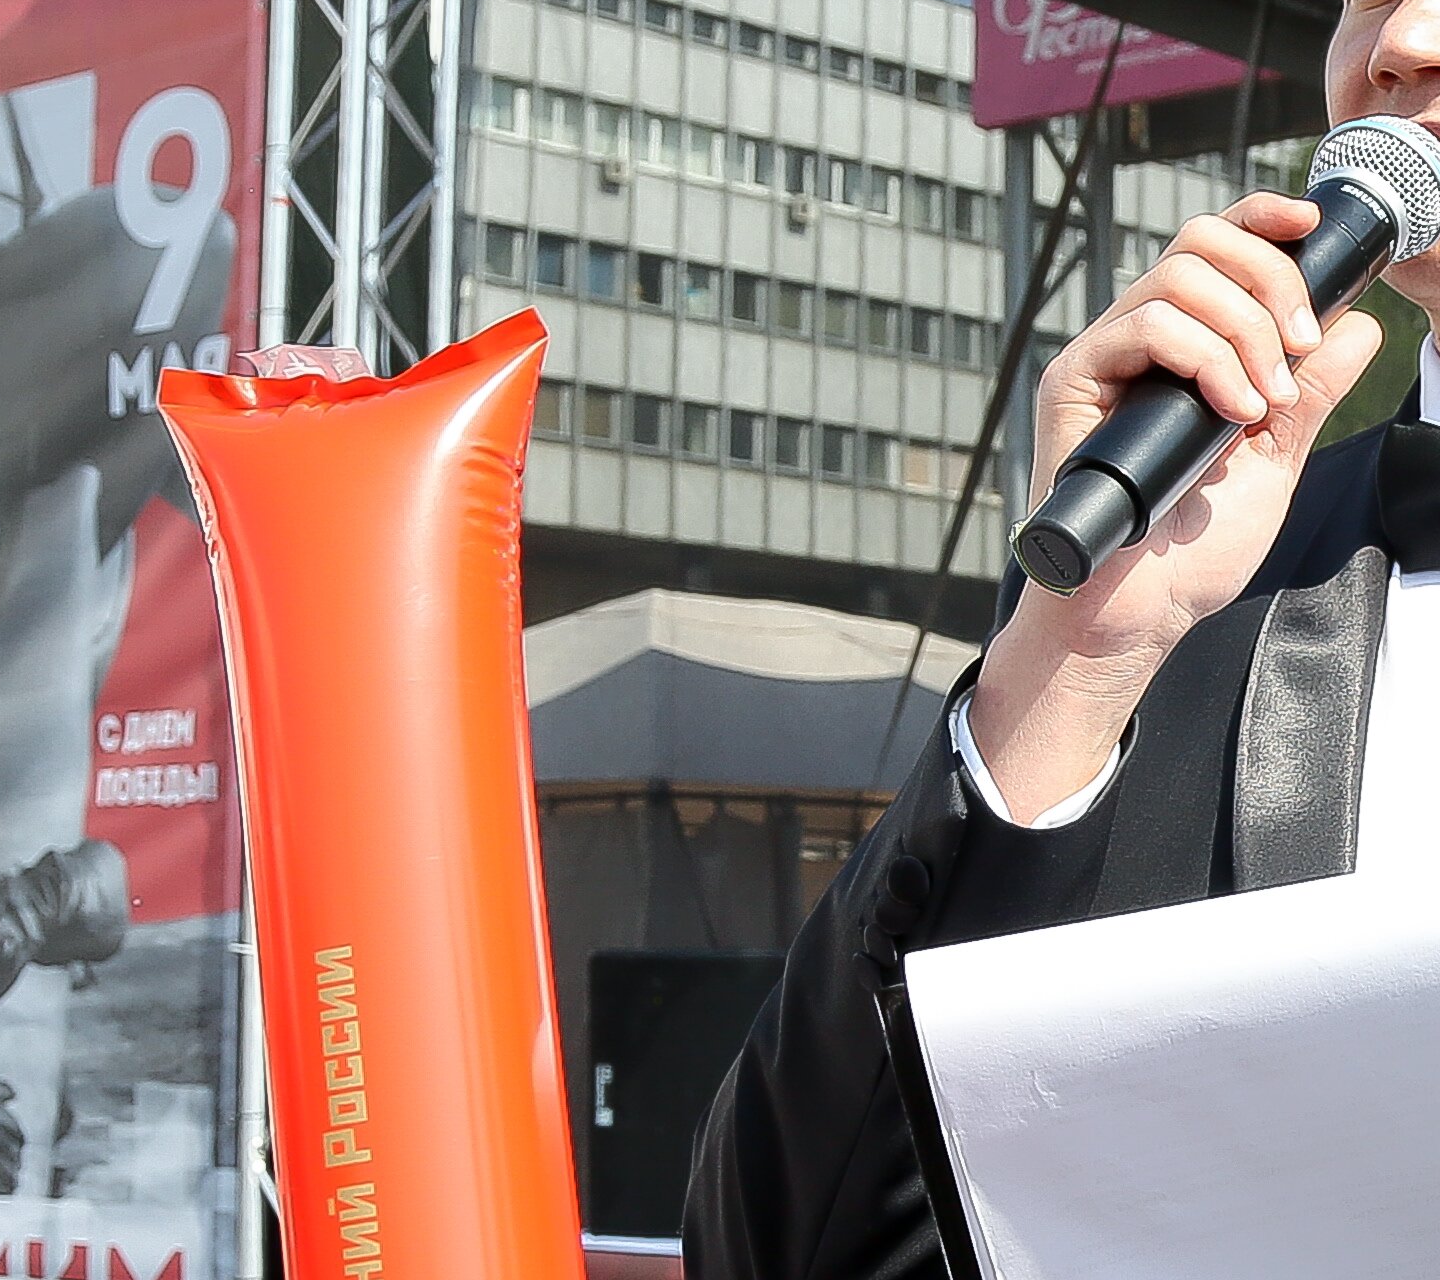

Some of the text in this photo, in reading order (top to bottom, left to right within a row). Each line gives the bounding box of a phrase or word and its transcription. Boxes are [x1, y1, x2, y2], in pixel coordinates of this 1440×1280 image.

[113, 84, 232, 335] 9
[97, 714, 122, 753] С
[314, 944, 373, 1170] РОССИИ
